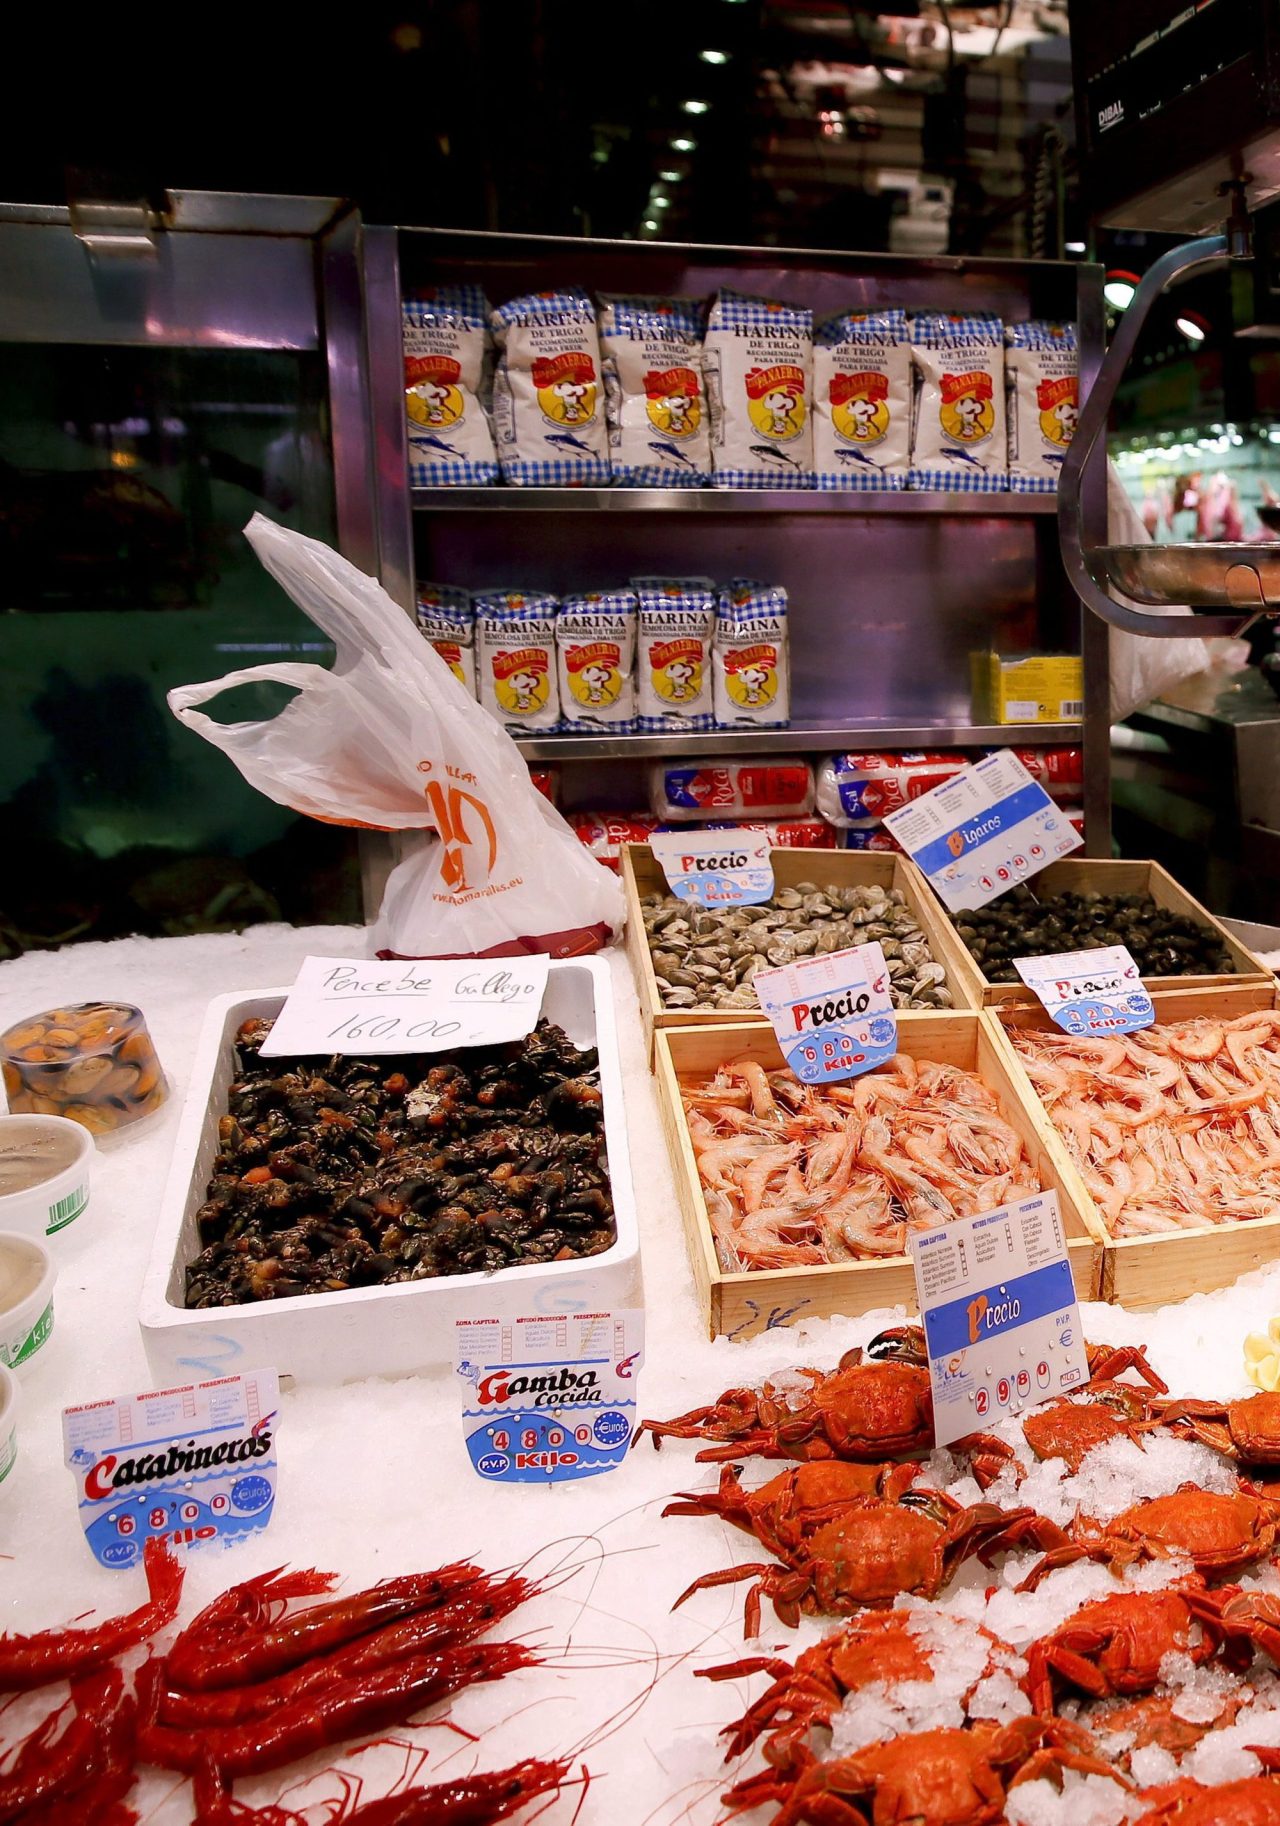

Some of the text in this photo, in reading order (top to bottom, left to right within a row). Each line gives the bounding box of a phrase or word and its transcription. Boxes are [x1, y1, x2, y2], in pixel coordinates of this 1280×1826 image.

[1099, 100, 1124, 126] DIBAL
[516, 312, 595, 328] HARINA
[531, 327, 583, 338] DE TRIGO
[735, 325, 812, 341] HARINA
[750, 341, 799, 349] DE TRIGO
[926, 335, 997, 350] HARINA
[852, 348, 885, 357] TRIGO
[641, 613, 709, 624] HARINA
[485, 621, 551, 633] HARINA
[674, 769, 732, 807] Sal Roca
[846, 791, 858, 813] Sal
[681, 852, 748, 872] Precio
[792, 990, 870, 1031] Precio
[1089, 1018, 1127, 1029] Kilo
[824, 1053, 866, 1072] Kilo
[966, 1294, 1021, 1344] Precio
[478, 1368, 600, 1405] Gamba
[84, 1400, 115, 1410] CAPTURA
[535, 1388, 601, 1407] cocida
[85, 1431, 272, 1500] Carabineros
[516, 1453, 578, 1468] Kilo
